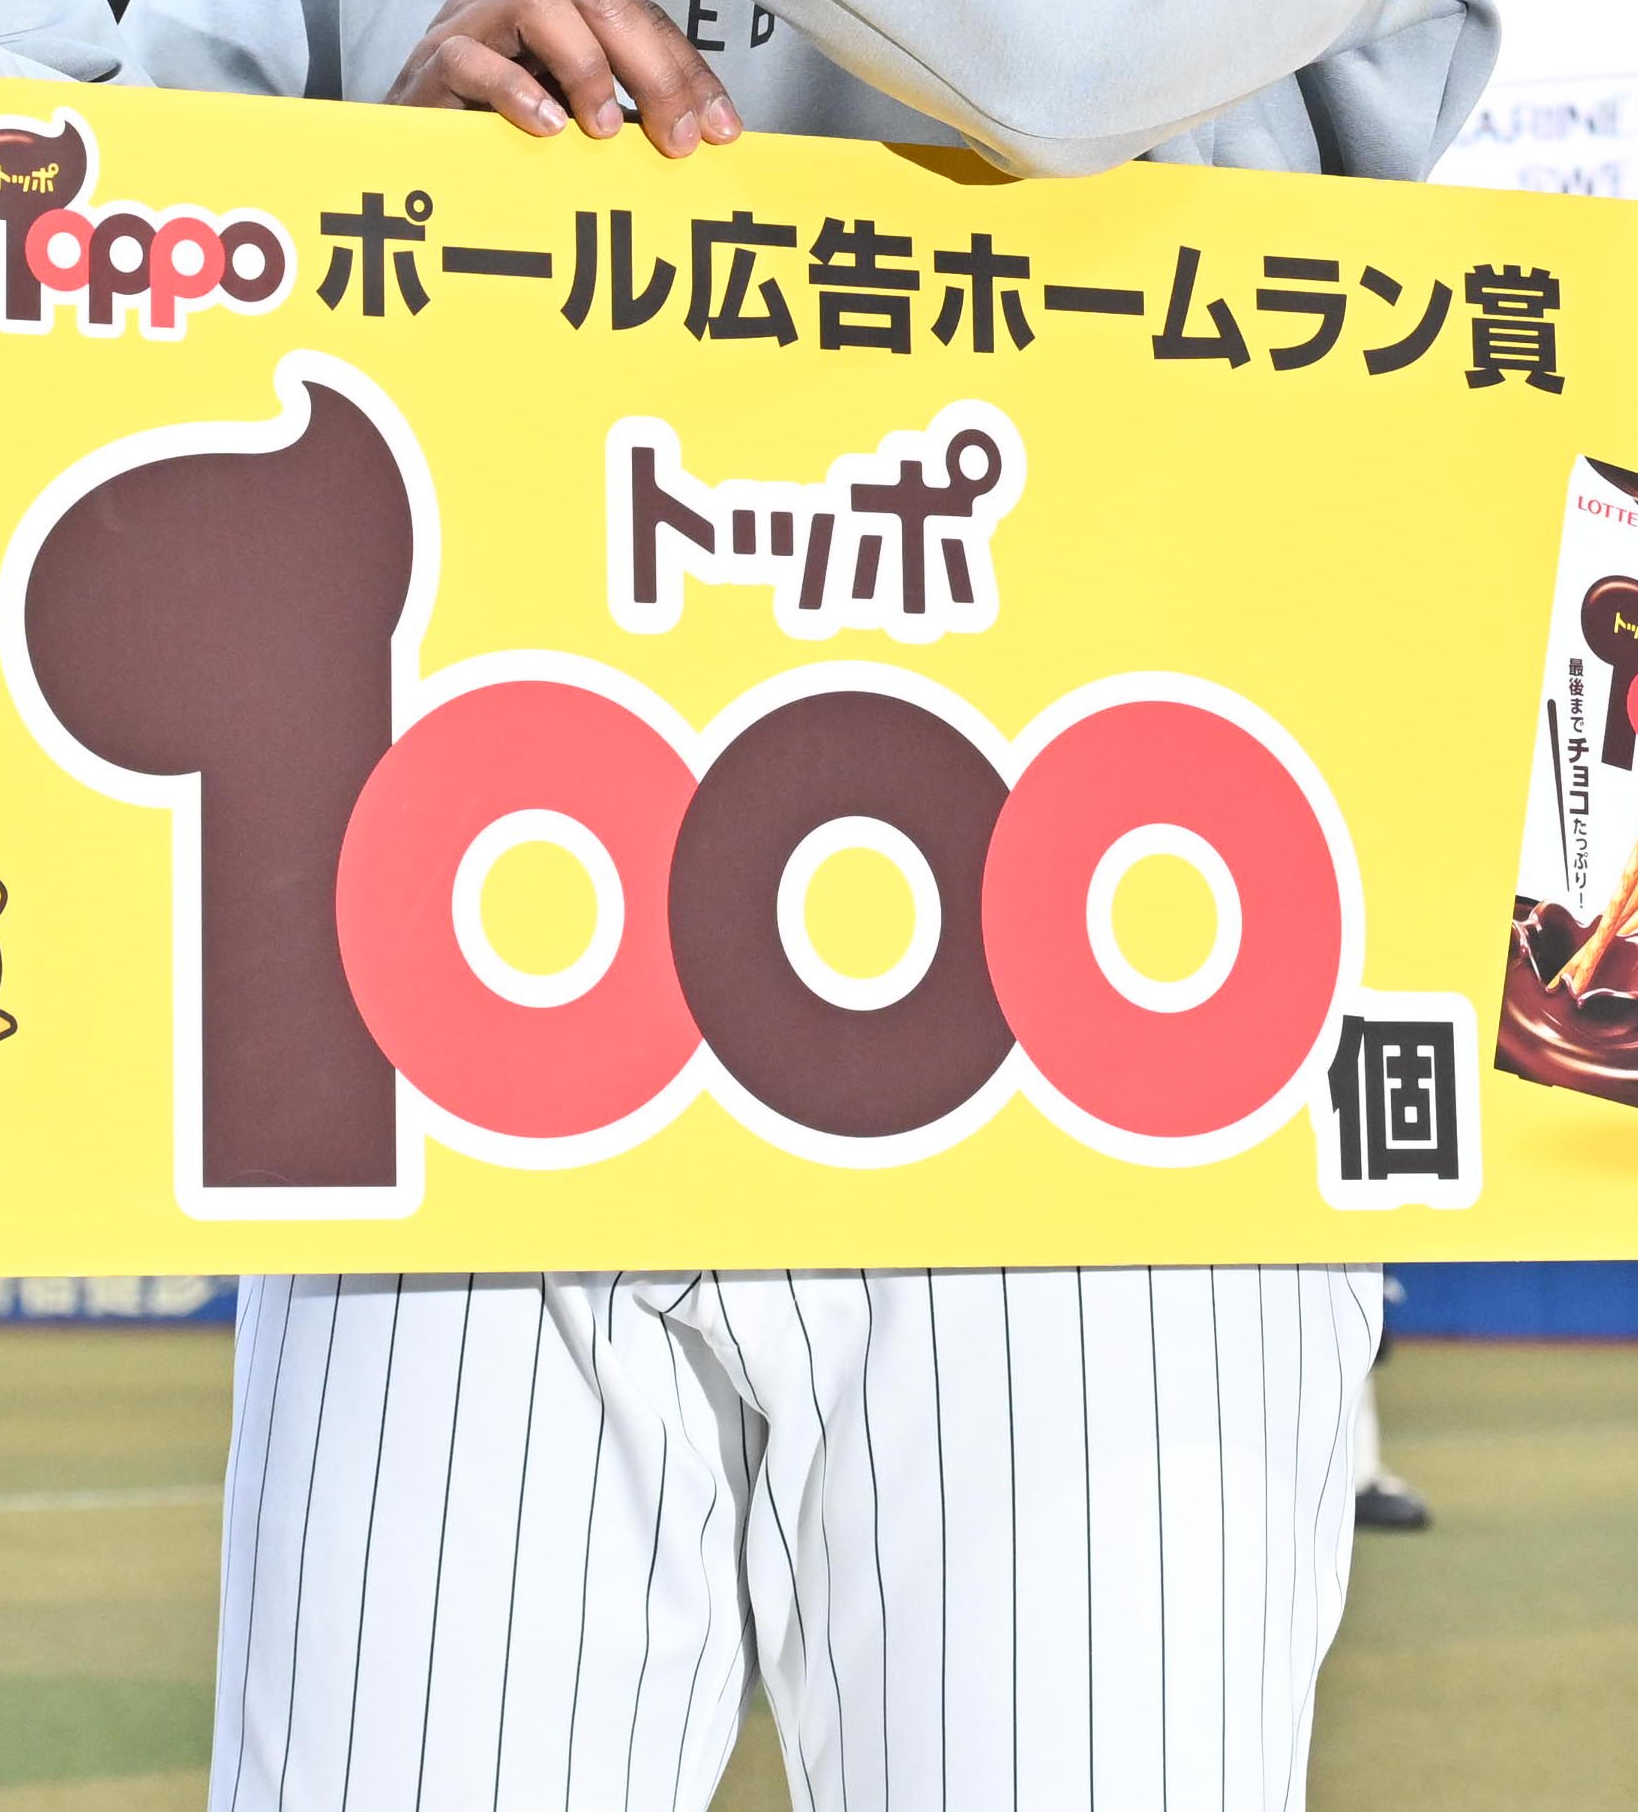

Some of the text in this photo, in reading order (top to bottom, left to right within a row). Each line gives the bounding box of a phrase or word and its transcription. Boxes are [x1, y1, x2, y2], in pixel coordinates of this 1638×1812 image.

[316, 190, 1566, 395] ポール広告ホームラン賞
[630, 427, 1003, 615] トッポ
